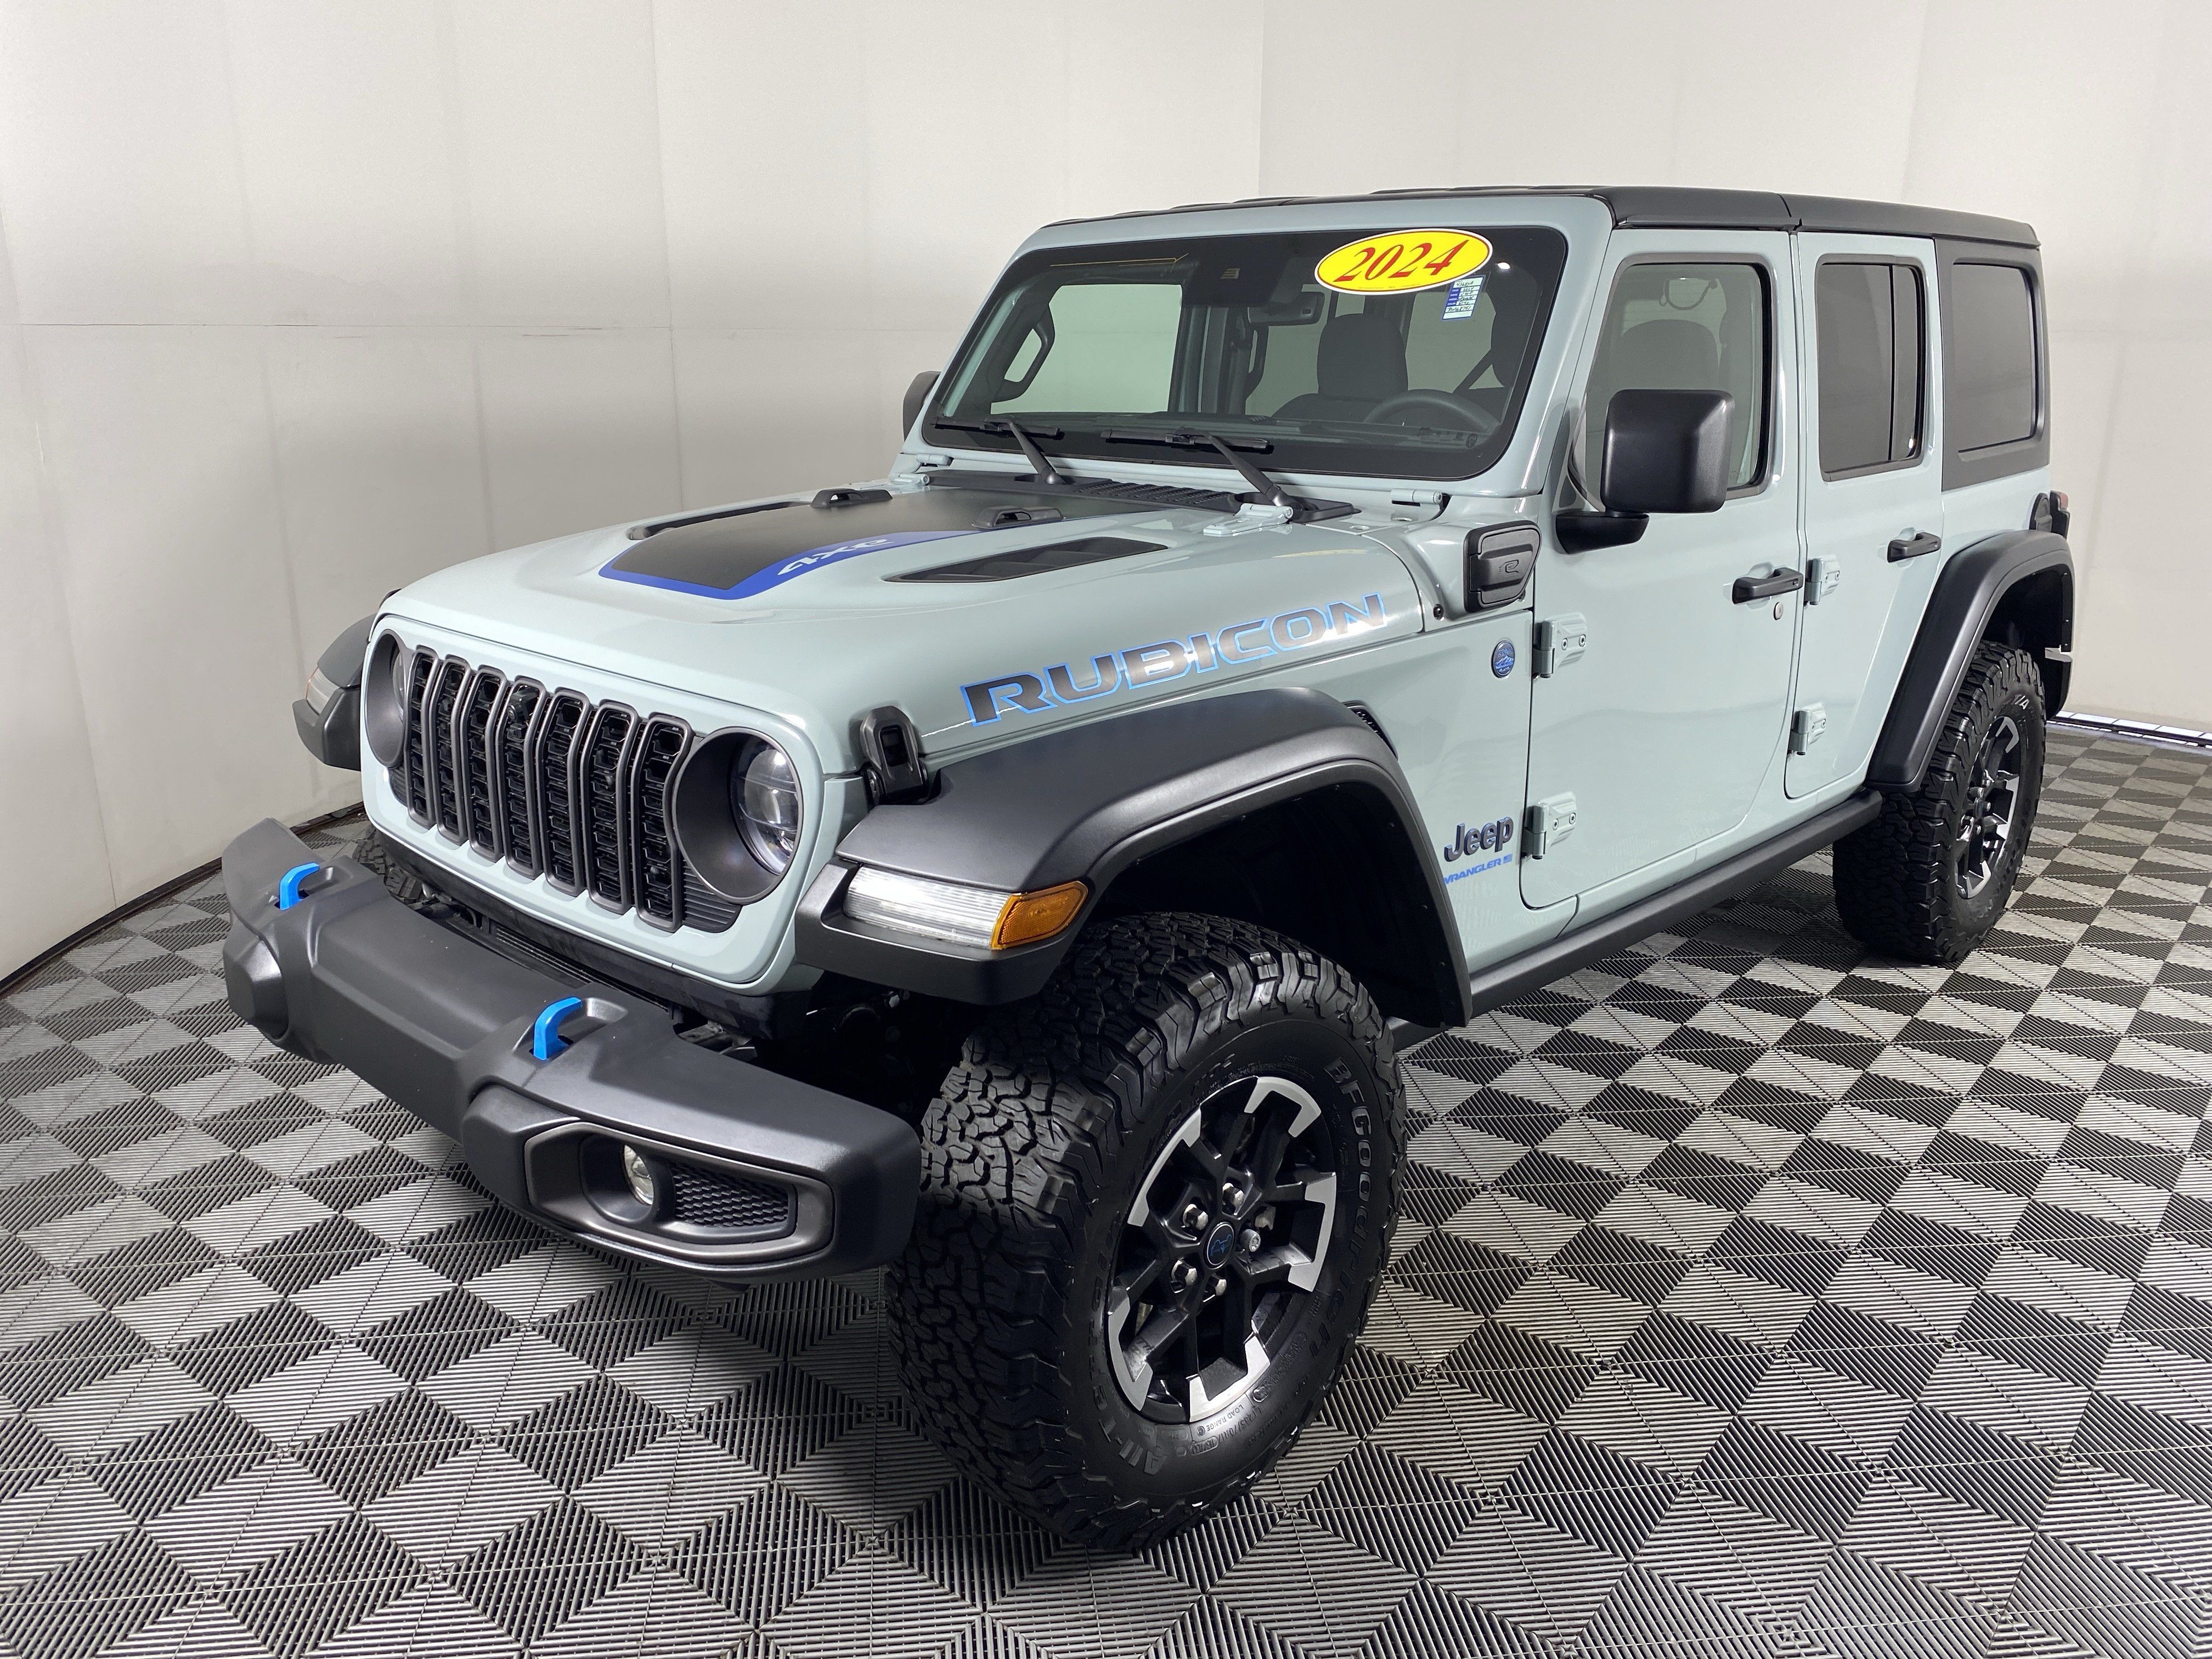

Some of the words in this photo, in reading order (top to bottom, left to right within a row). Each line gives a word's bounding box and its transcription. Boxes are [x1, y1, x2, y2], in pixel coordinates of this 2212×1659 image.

[1333, 240, 1469, 282] 2024
[777, 539, 895, 575] 4xe
[960, 592, 1389, 727] RUBICON
[1444, 816, 1514, 862] Jeep
[1443, 858, 1502, 885] WRANGLER
[1206, 1417, 1227, 1432] RANGE
[1227, 1404, 1244, 1419] LOAD
